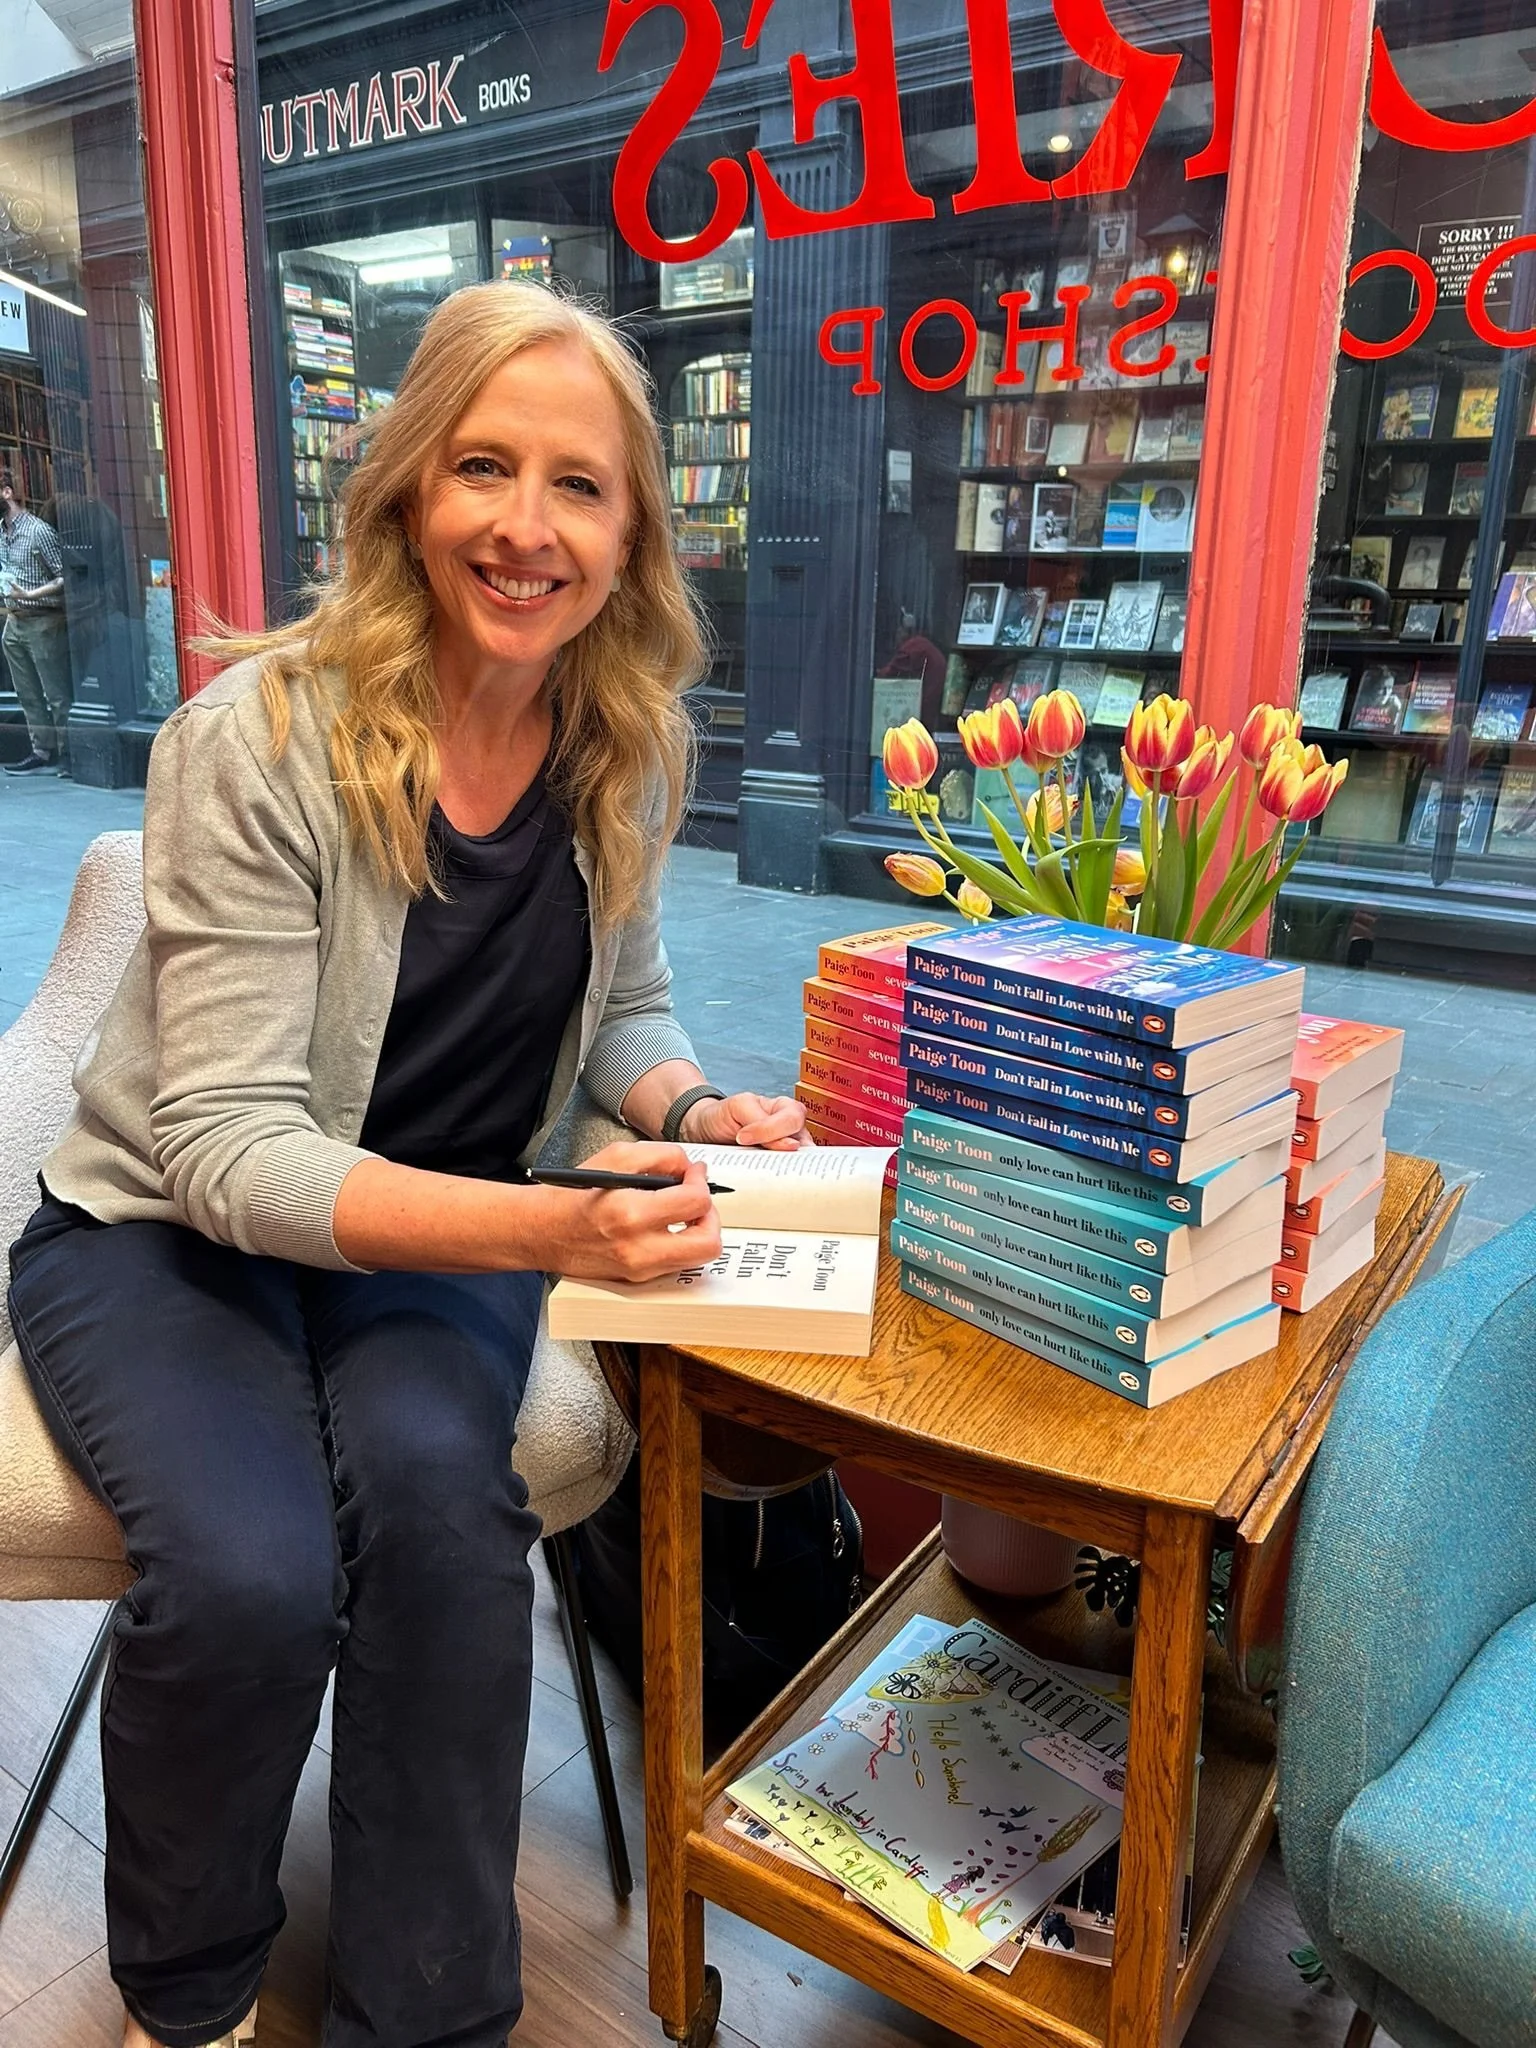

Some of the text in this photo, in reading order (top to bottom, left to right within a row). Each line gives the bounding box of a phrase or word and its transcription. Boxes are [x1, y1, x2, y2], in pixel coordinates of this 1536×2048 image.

[259, 54, 531, 164] UTMARK BOOKS
[1432, 254, 1472, 265] DISPLAY
[1439, 227, 1495, 244] SORRY
[1457, 244, 1482, 253] BOOKS
[1435, 265, 1448, 274] ARE
[1450, 263, 1464, 272] NOT
[824, 957, 850, 976] Paige
[850, 965, 875, 981] Toon
[1007, 933, 1099, 957] Don't
[1077, 949, 1162, 971] Love
[808, 993, 831, 1015] Paige
[831, 1000, 854, 1018] Toon
[862, 1010, 894, 1032] seven
[914, 956, 1135, 1025] Paige Toon Don't Fall in Love with Me
[811, 1028, 898, 1067] Paige Toon seven
[912, 1000, 1144, 1072] Paige Toon Don't Fall in Love with Me
[805, 1061, 829, 1080] Paige
[861, 1083, 890, 1101] seven
[909, 1043, 1146, 1116] Paige Toon Don't Fall in Love with Me
[800, 1095, 883, 1138] Paige Toon seven
[915, 1078, 1140, 1157] Paige Toon Don't Fall in Love with Me
[912, 1129, 951, 1153] Paige
[954, 1138, 993, 1162] Toon
[999, 1154, 1024, 1171] only
[1026, 1158, 1050, 1175] love
[1052, 1168, 1073, 1182] can
[1076, 1170, 1104, 1188] hurt
[1107, 1178, 1131, 1196] like
[1133, 1184, 1159, 1202] this
[906, 1160, 941, 1186] Paige
[943, 1171, 978, 1196] Toon
[983, 1189, 1007, 1206] only
[1008, 1194, 1029, 1212] love
[1031, 1204, 1051, 1219] can
[1052, 1207, 1078, 1228] hurt
[1080, 1218, 1103, 1236] like
[1104, 1225, 1128, 1245] this
[736, 1241, 769, 1279] Fall in
[766, 1244, 797, 1279] Don't
[812, 1239, 841, 1291] Paige Toon
[904, 1199, 1123, 1291] Paige Toon only love can hurt like this
[898, 1235, 1109, 1332] Paige Toon only love can hurt like this
[908, 1270, 1113, 1378] Paige Toon only love can hurt like this
[972, 1620, 1015, 1651] CELEBRATING
[1052, 1669, 1095, 1698] COMMUNITY
[927, 1713, 974, 1806] Hello Sunshine!
[772, 1752, 810, 1790] Spring
[876, 1828, 887, 1840] in
